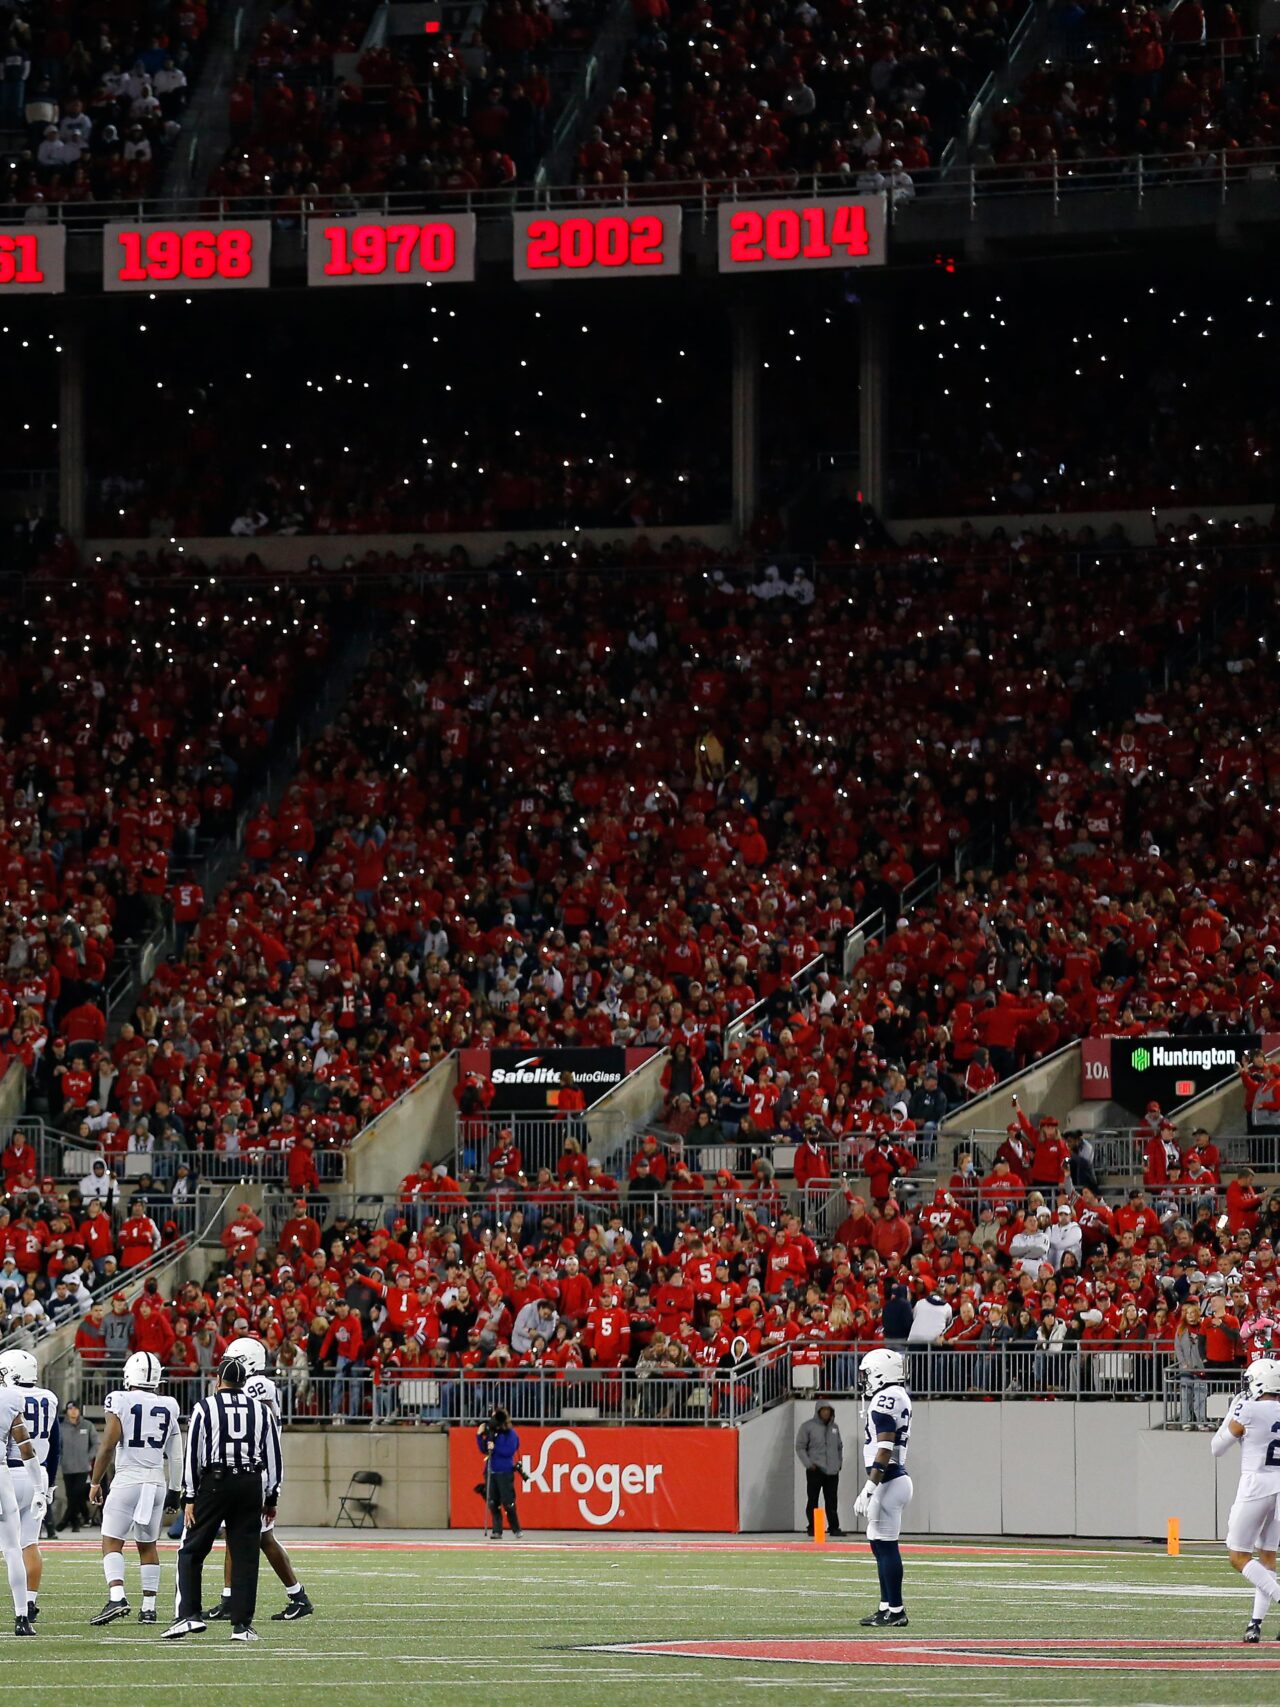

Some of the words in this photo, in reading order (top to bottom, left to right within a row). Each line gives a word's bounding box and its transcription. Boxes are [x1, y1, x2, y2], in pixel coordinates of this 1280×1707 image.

[526, 216, 663, 269] 2002
[729, 205, 869, 262] 2014
[118, 228, 253, 281] 1968
[323, 223, 456, 276] 1970
[181, 889, 192, 905] 5
[342, 996, 354, 1012] 12
[1152, 1046, 1236, 1071] Huntington
[1085, 1062, 1109, 1079] 10A
[755, 1094, 764, 1113] 7
[26, 1235, 37, 1252] 2
[700, 1264, 712, 1283] 5
[110, 1320, 125, 1340] 17
[416, 1317, 426, 1335] 7
[602, 1318, 612, 1336] 5
[247, 1382, 267, 1398] 92
[877, 1395, 895, 1410] 23
[24, 1396, 50, 1439] 91
[129, 1403, 171, 1449] 13
[226, 1407, 250, 1440] U
[521, 1428, 663, 1526] Kroger
